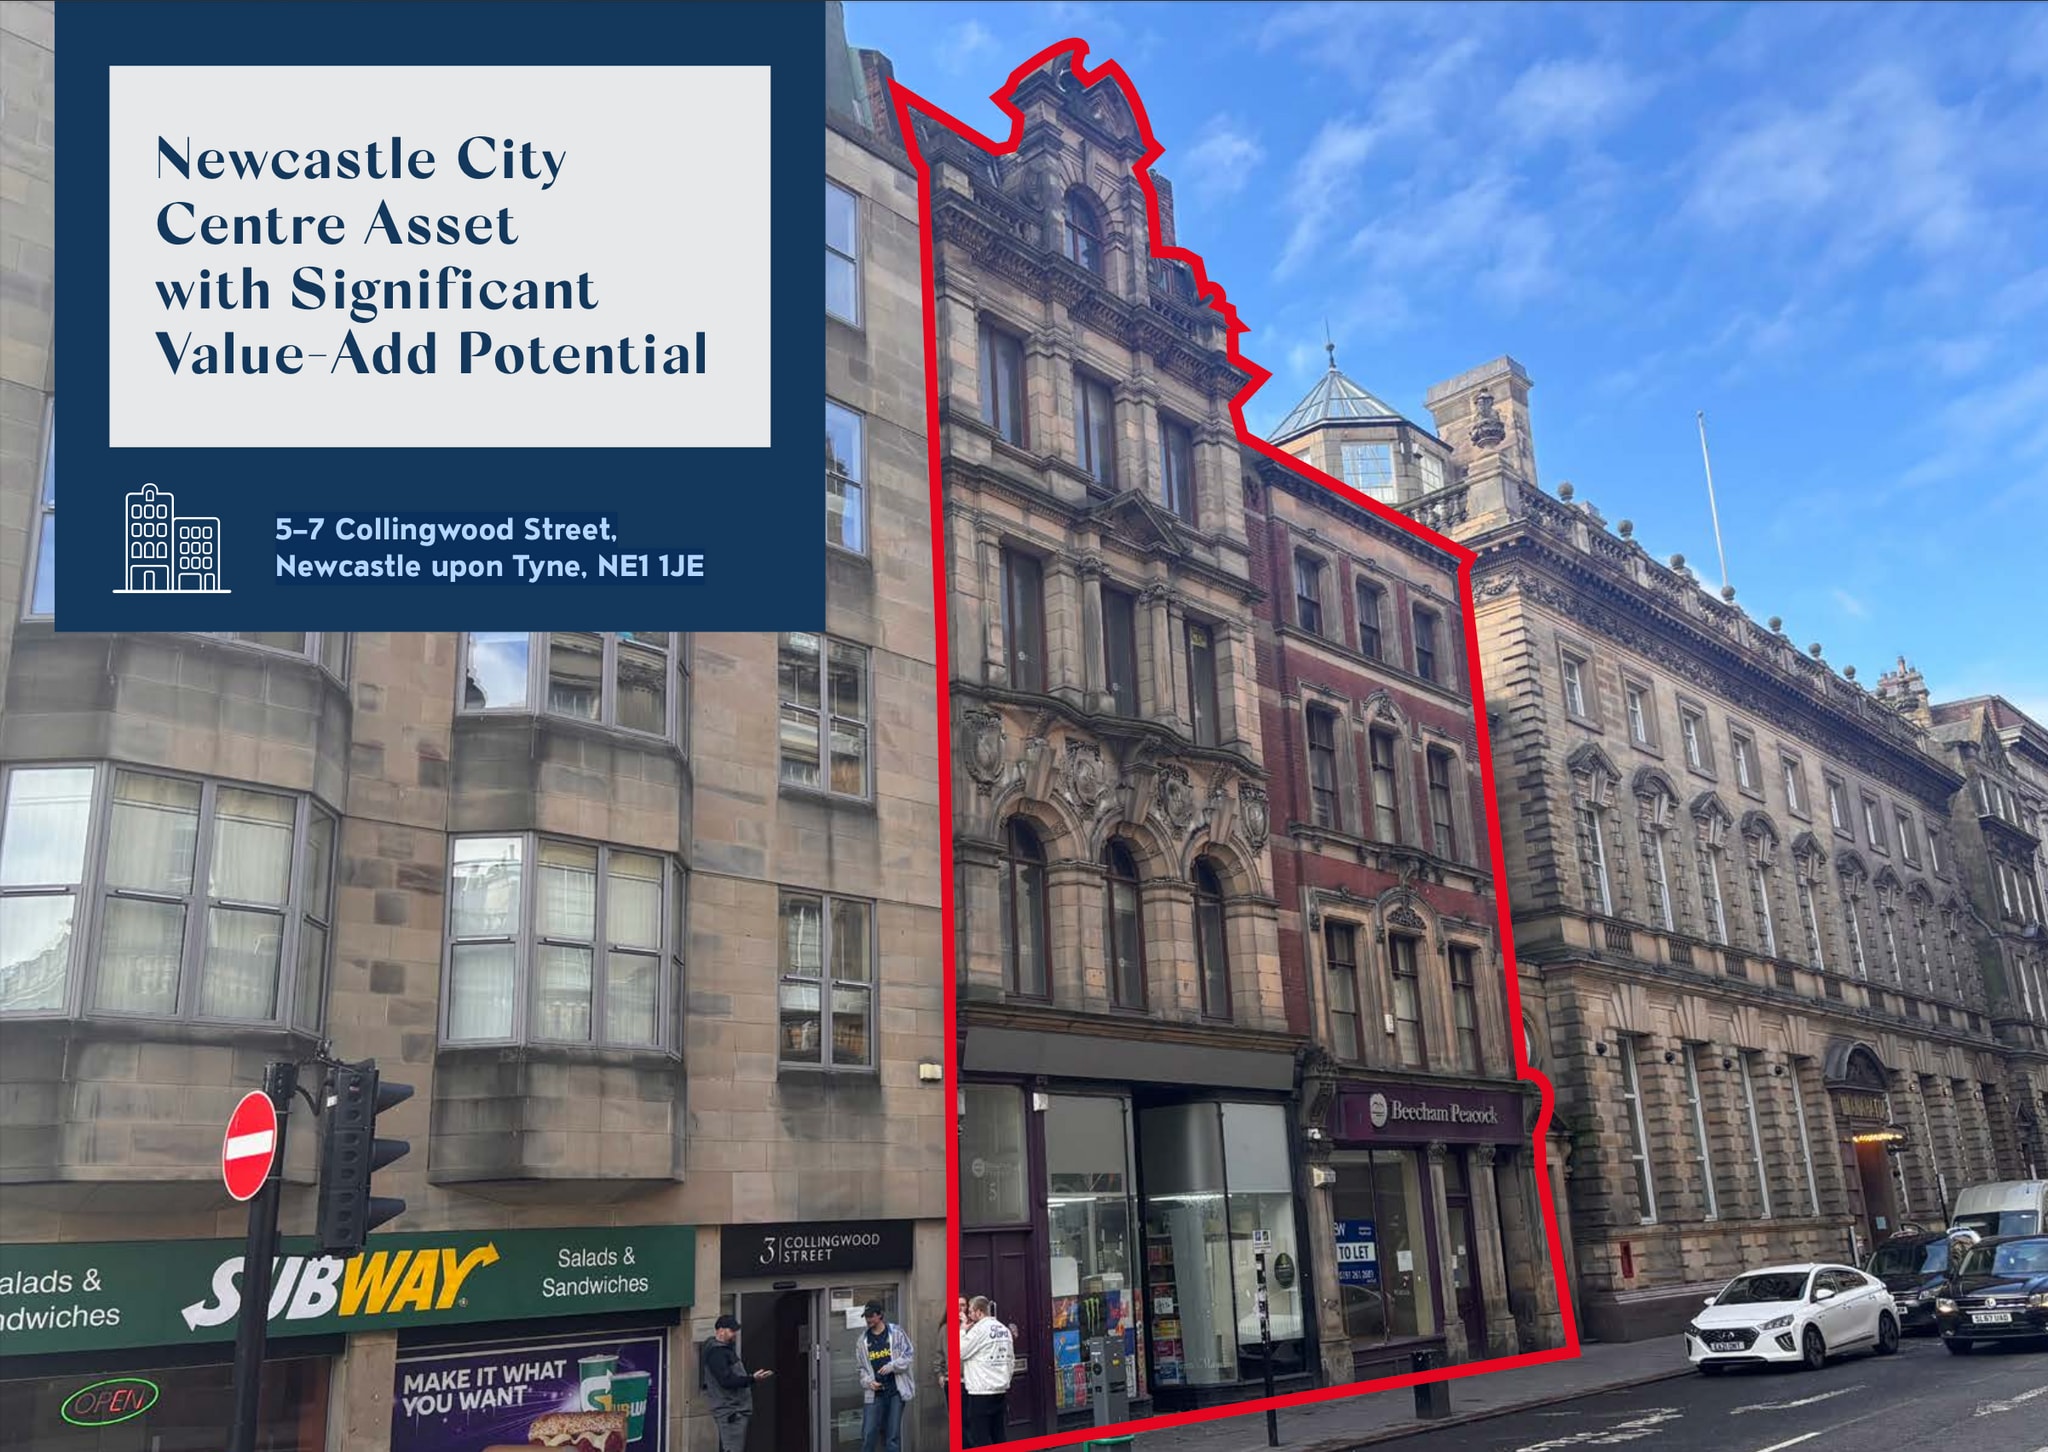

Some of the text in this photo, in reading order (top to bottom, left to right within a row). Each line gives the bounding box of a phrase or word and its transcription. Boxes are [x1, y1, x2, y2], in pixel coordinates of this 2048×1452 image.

[1391, 1099, 1498, 1124] Beecham Peacock
[558, 1246, 635, 1268] Salads &
[760, 1233, 880, 1264] 3 COLLINGWOOD
[784, 1249, 833, 1263] STREET
[1338, 1245, 1369, 1260] TO LET
[0, 1268, 102, 1295] alads &
[181, 1241, 501, 1332] SUBWAY
[542, 1275, 649, 1298] Sandwiches
[0, 1304, 121, 1332] dwiches
[403, 1360, 567, 1395] MAKE IT WHAT
[74, 1386, 147, 1415] OPEN
[402, 1385, 528, 1417] YOU WANT
